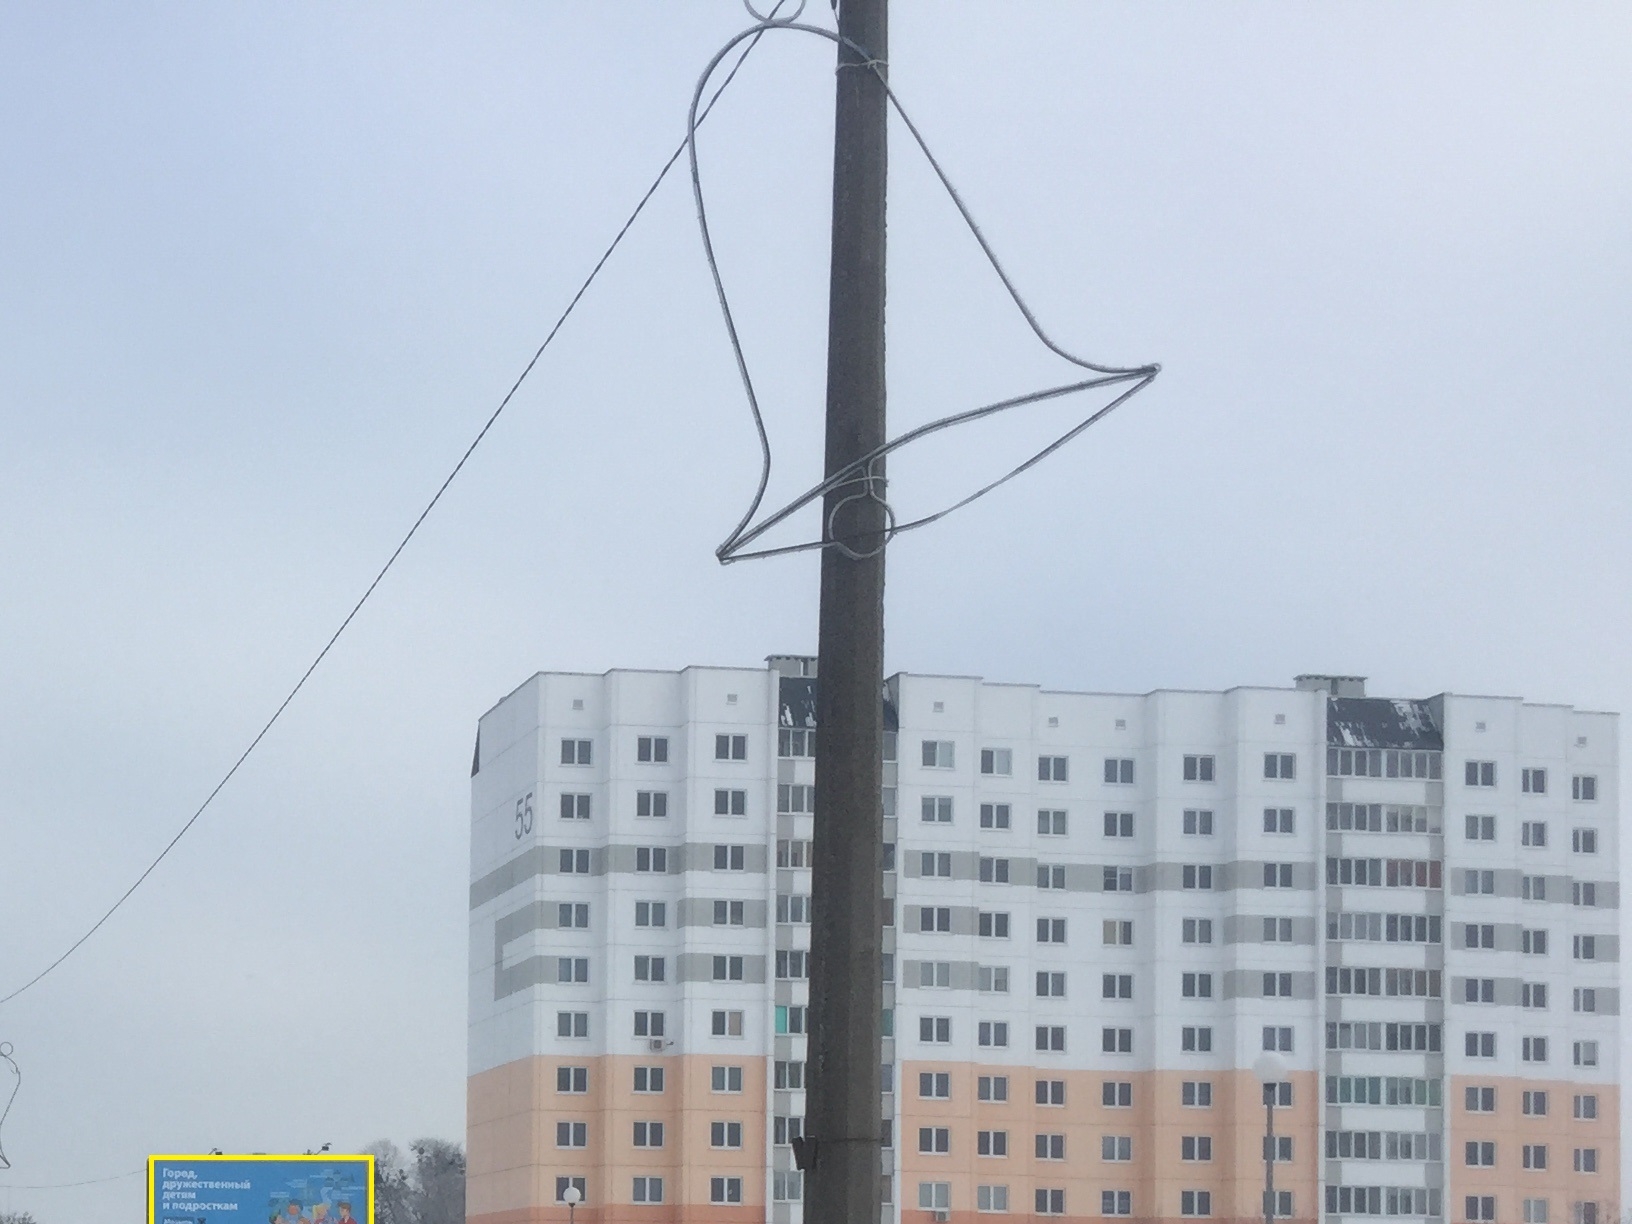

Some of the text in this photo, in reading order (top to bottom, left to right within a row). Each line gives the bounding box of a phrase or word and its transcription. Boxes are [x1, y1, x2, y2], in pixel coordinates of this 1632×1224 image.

[515, 792, 533, 840] 55
[163, 1168, 197, 1179] Город,
[162, 1180, 251, 1190] дружественный
[162, 1191, 196, 1200] детям
[172, 1202, 238, 1211] подросткам
